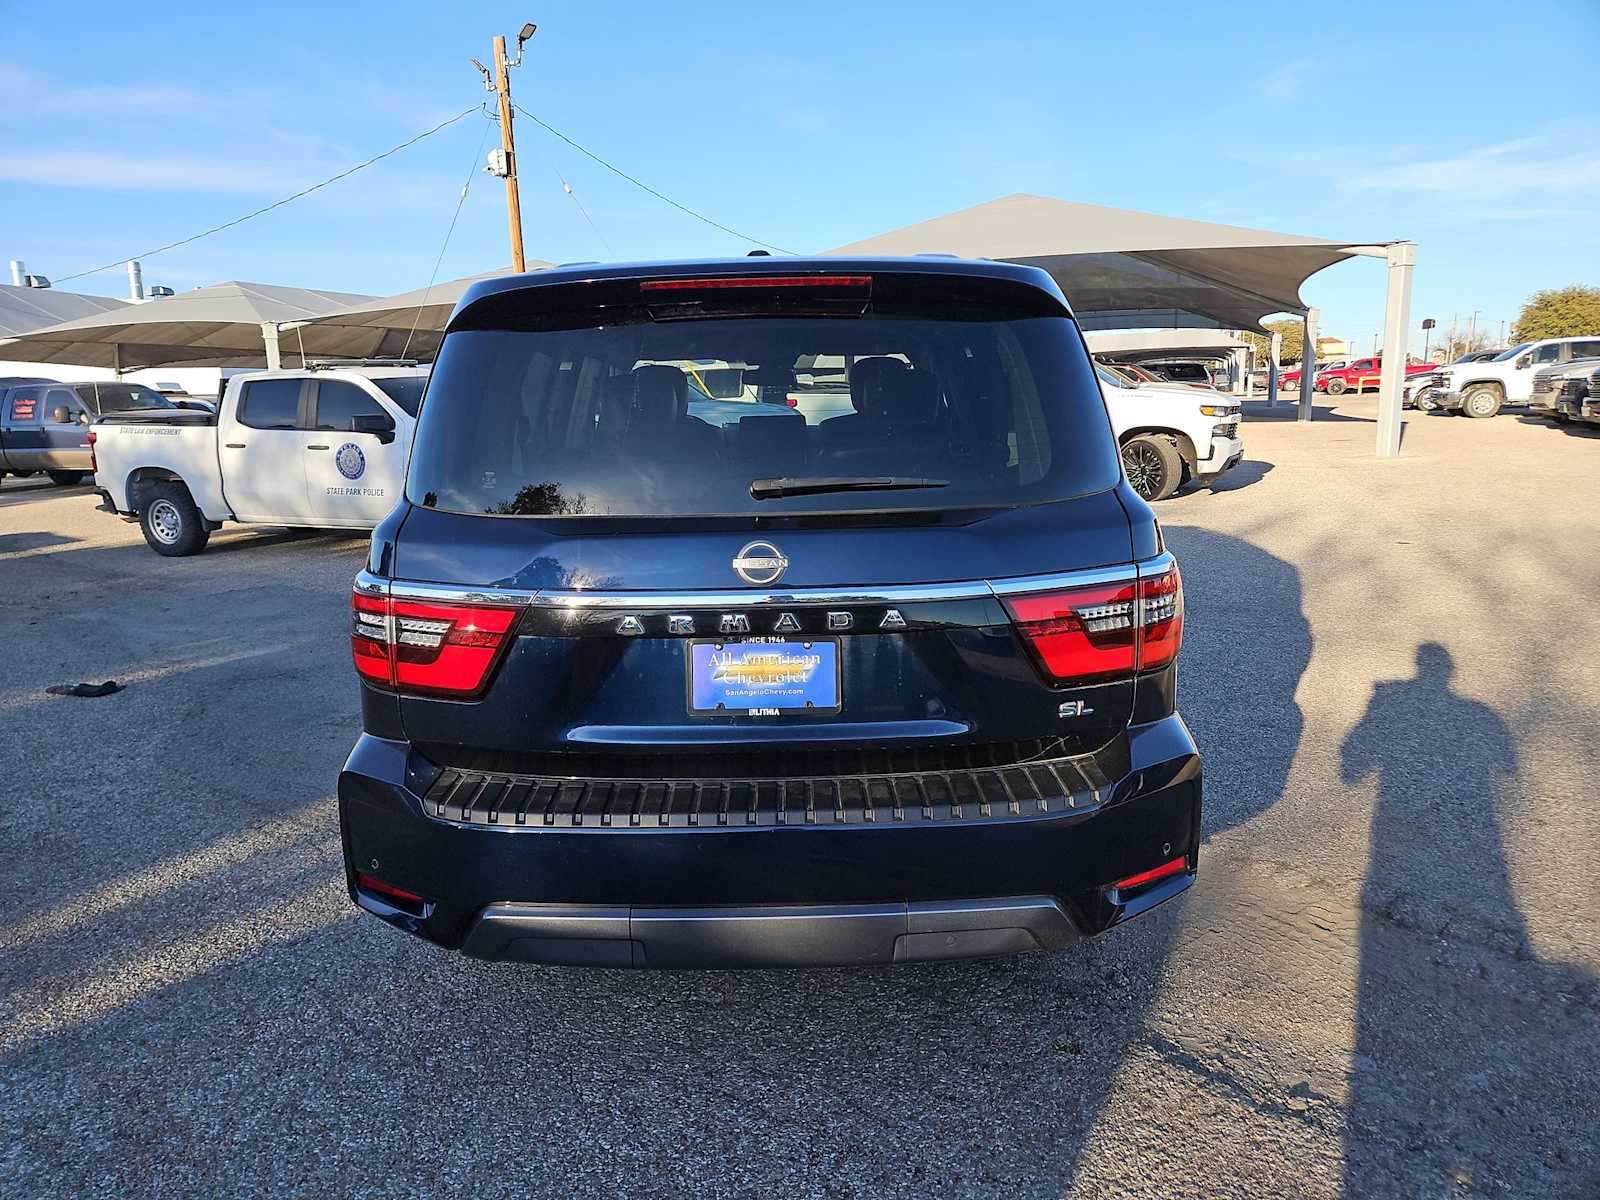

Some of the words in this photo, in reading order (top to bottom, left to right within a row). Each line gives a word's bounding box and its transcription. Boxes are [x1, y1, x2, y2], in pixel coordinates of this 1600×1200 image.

[145, 428, 182, 436] ENFORCEMENT
[326, 487, 344, 495] STATE
[345, 487, 361, 496] PARK
[363, 488, 385, 497] POLICE
[616, 609, 907, 635] ARMADA
[708, 652, 732, 667] All
[739, 652, 821, 668] American
[723, 669, 808, 684] Chevrolet
[725, 688, 804, 697] SanAngeloChevy.com
[1059, 700, 1094, 718] SL
